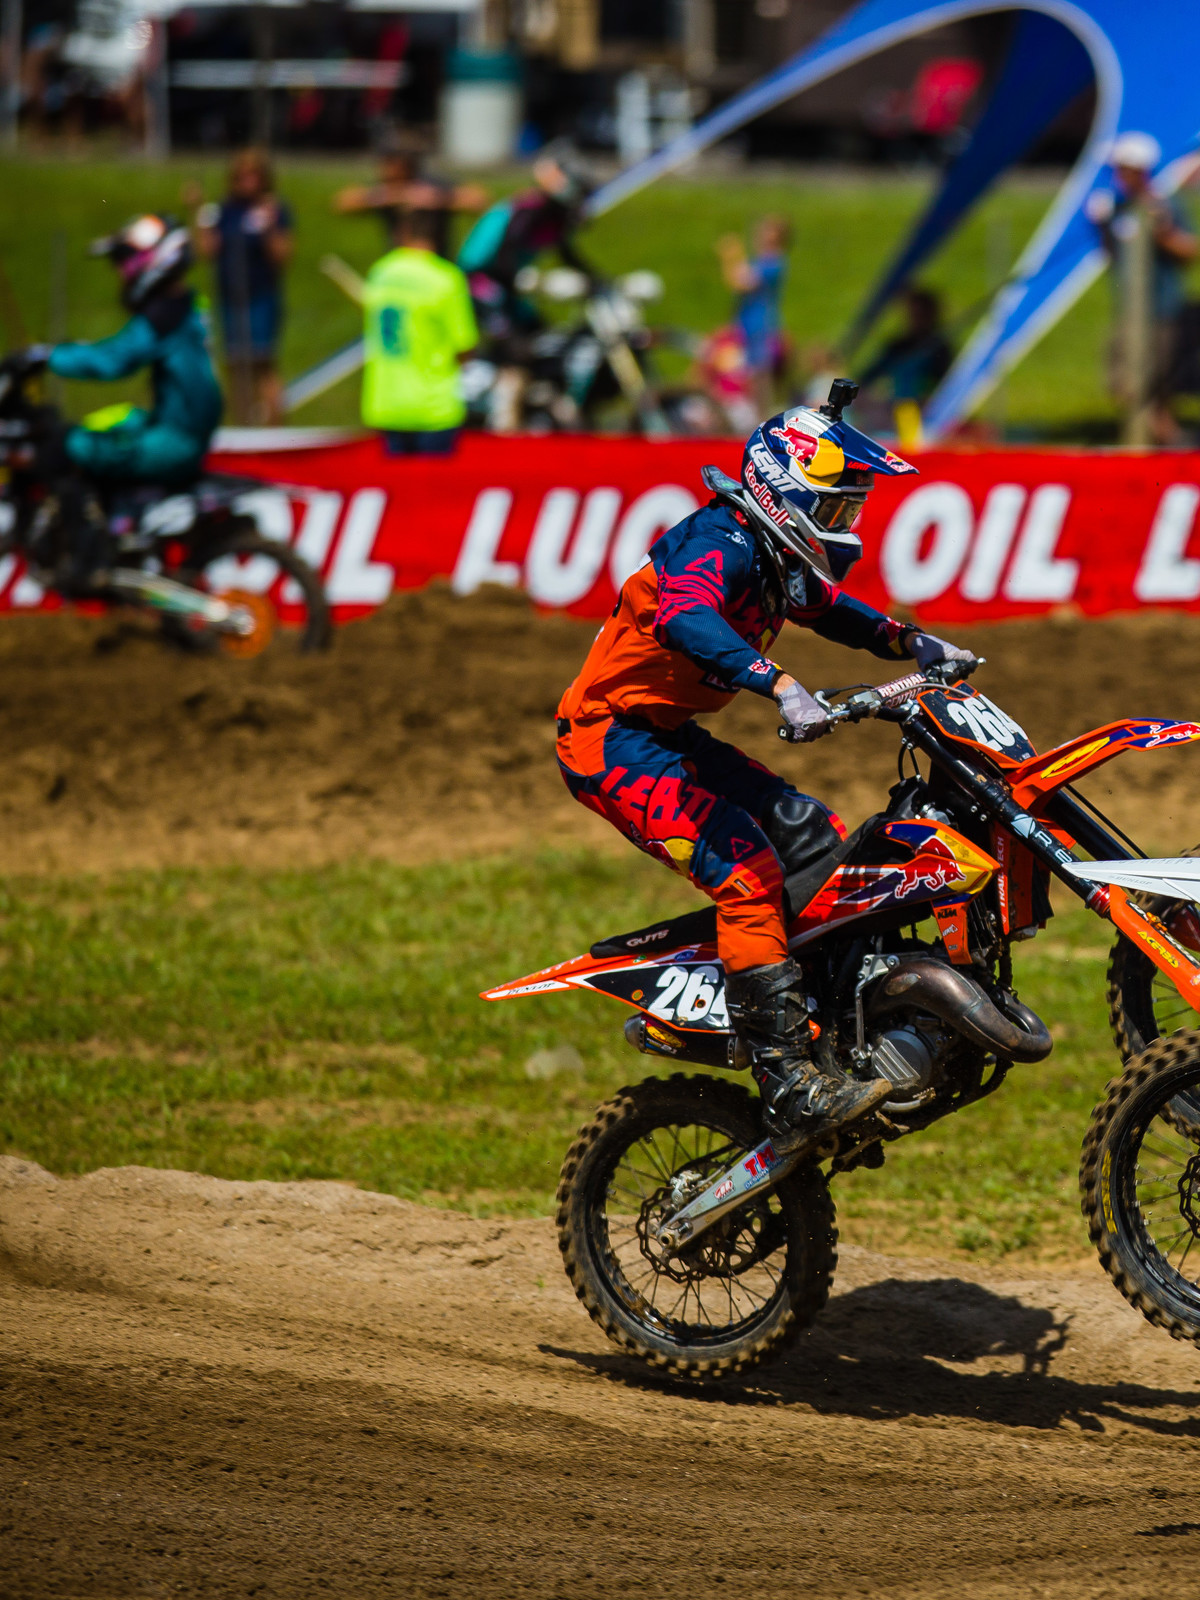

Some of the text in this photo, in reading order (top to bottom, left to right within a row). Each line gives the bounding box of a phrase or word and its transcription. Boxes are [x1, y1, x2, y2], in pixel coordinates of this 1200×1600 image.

[750, 442, 808, 494] LEATT
[453, 481, 1079, 607] LUC OIL
[877, 673, 927, 698] RENTHAL
[946, 694, 1028, 752] 264
[937, 907, 957, 919] KTM
[626, 929, 670, 947] GUTS
[744, 1144, 776, 1178] TM
